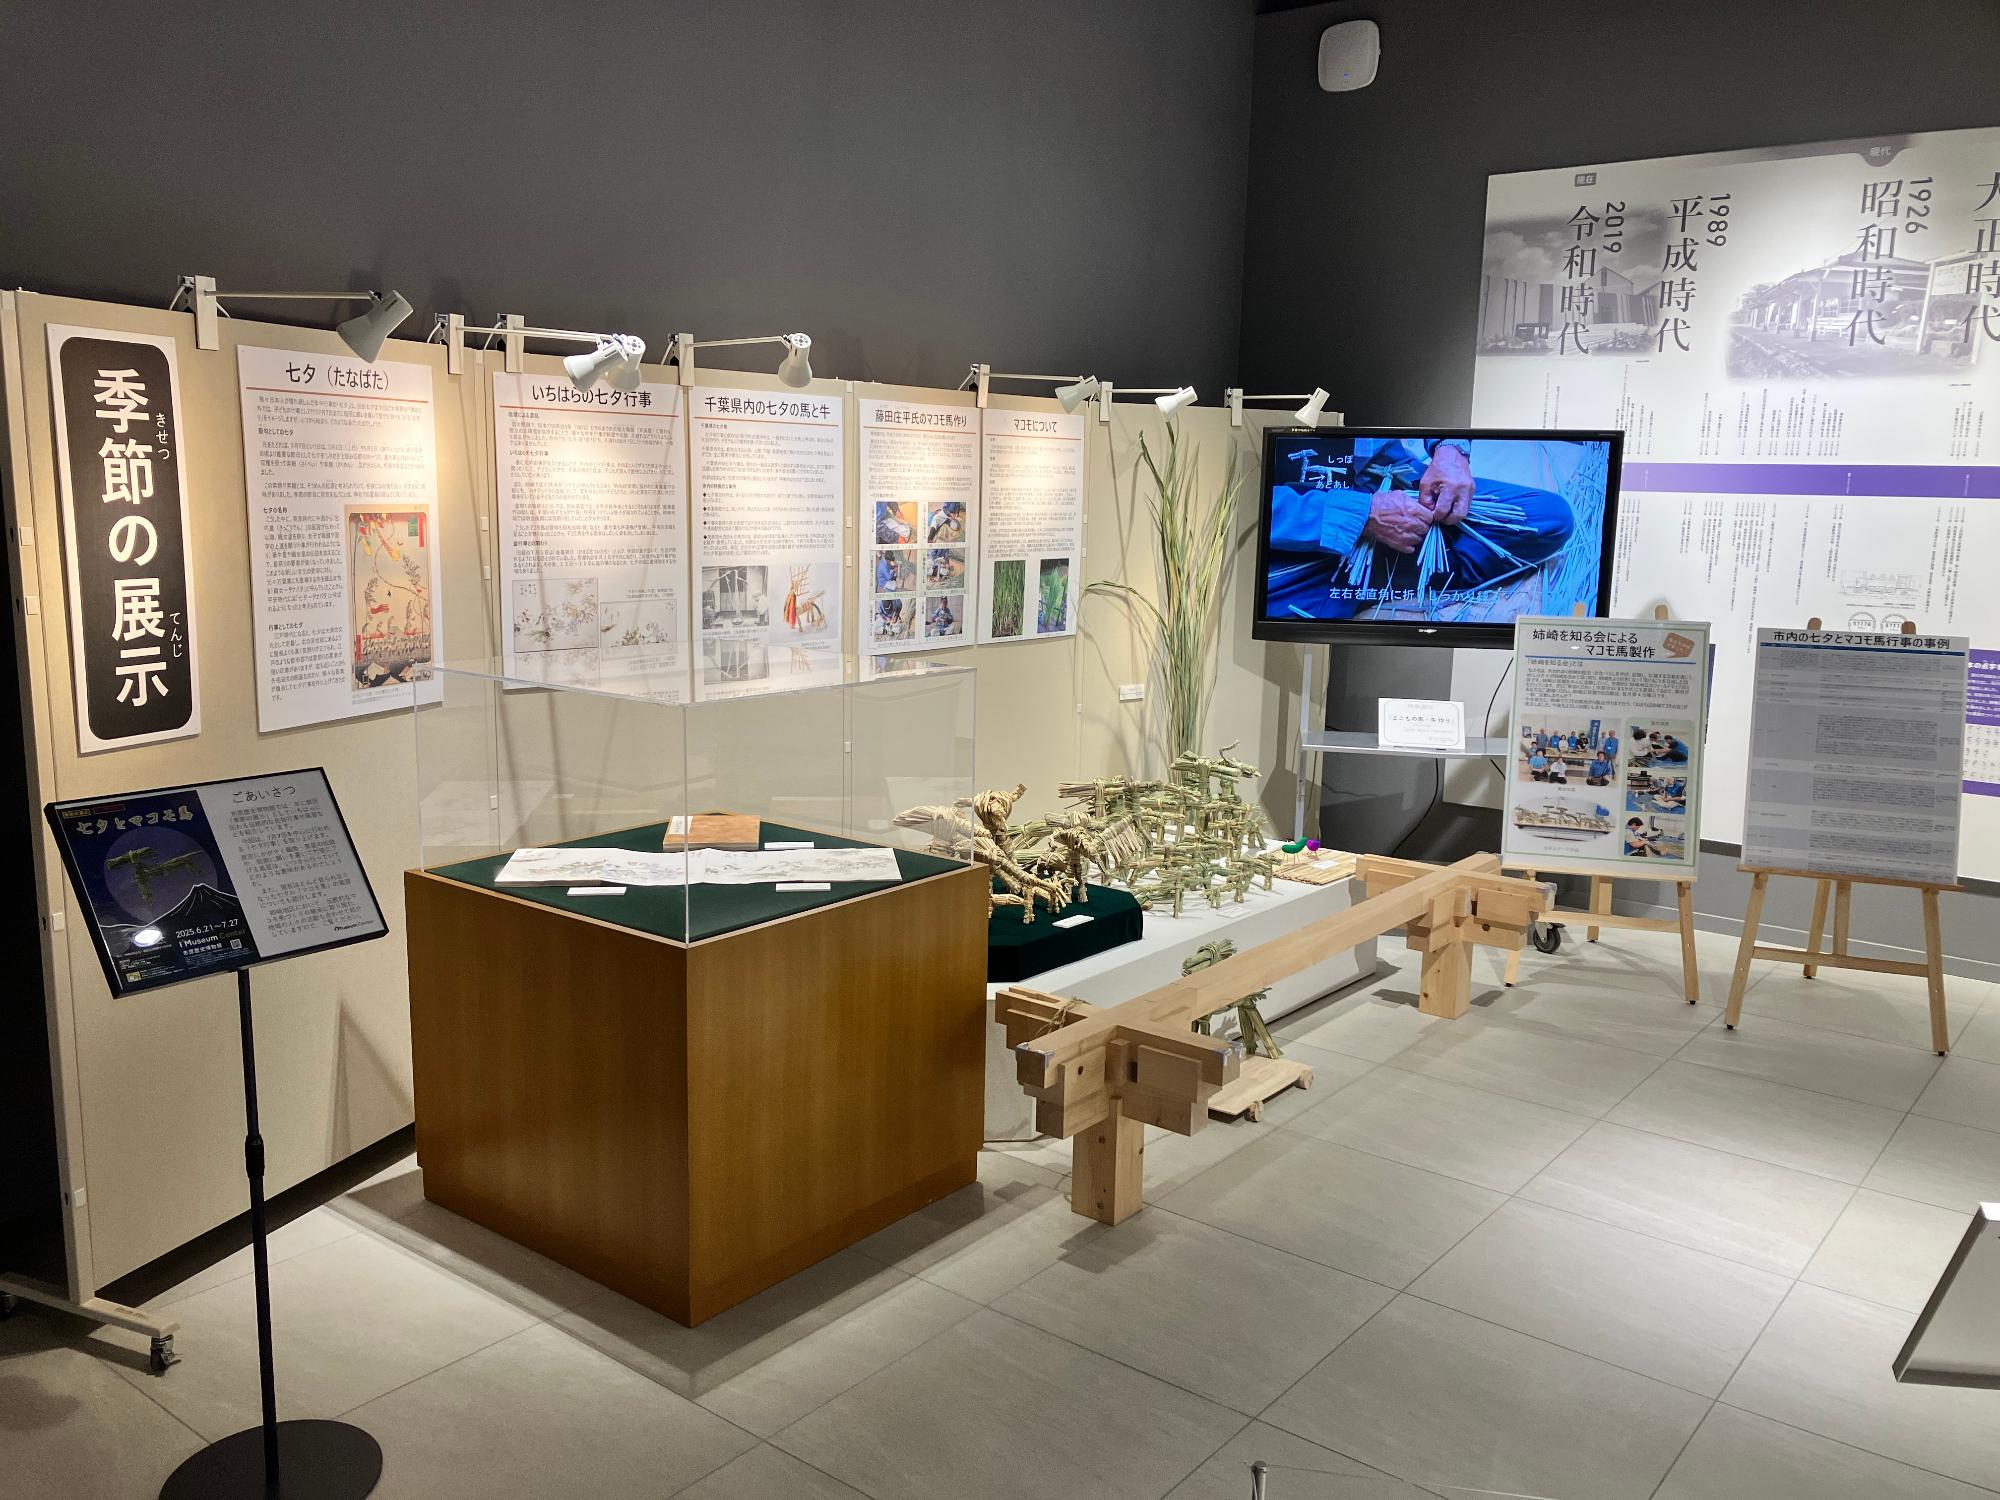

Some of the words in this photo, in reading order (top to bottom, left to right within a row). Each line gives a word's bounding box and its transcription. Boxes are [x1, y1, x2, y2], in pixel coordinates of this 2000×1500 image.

[1706, 193, 1731, 247] 1989
[1905, 176, 1933, 234] 1926
[1603, 201, 1626, 254] 2019
[1655, 195, 1704, 353] 平成時代
[1846, 178, 1903, 347] 昭和時代
[1557, 205, 1600, 356] 令和時代
[532, 384, 652, 408] いちはらの七夕行事
[704, 396, 831, 420] 千葉県内の七夕の馬と牛
[875, 409, 967, 428] 藤田庄平氏のマコモ馬作り
[1014, 418, 1058, 433] マコモについて
[155, 411, 171, 460] きせつ
[1316, 480, 1350, 489] あとあし
[93, 368, 169, 707] 季節の展示
[170, 612, 184, 658] てんじ
[1532, 629, 1638, 644] 姉崎を知る会による
[1774, 631, 1950, 650] 市内の七夕とマコモ馬行事の事例
[1586, 645, 1656, 658] マコモ馬製作
[232, 785, 296, 804] ごあいさつ
[76, 805, 194, 835] 七夕とマコモ馬
